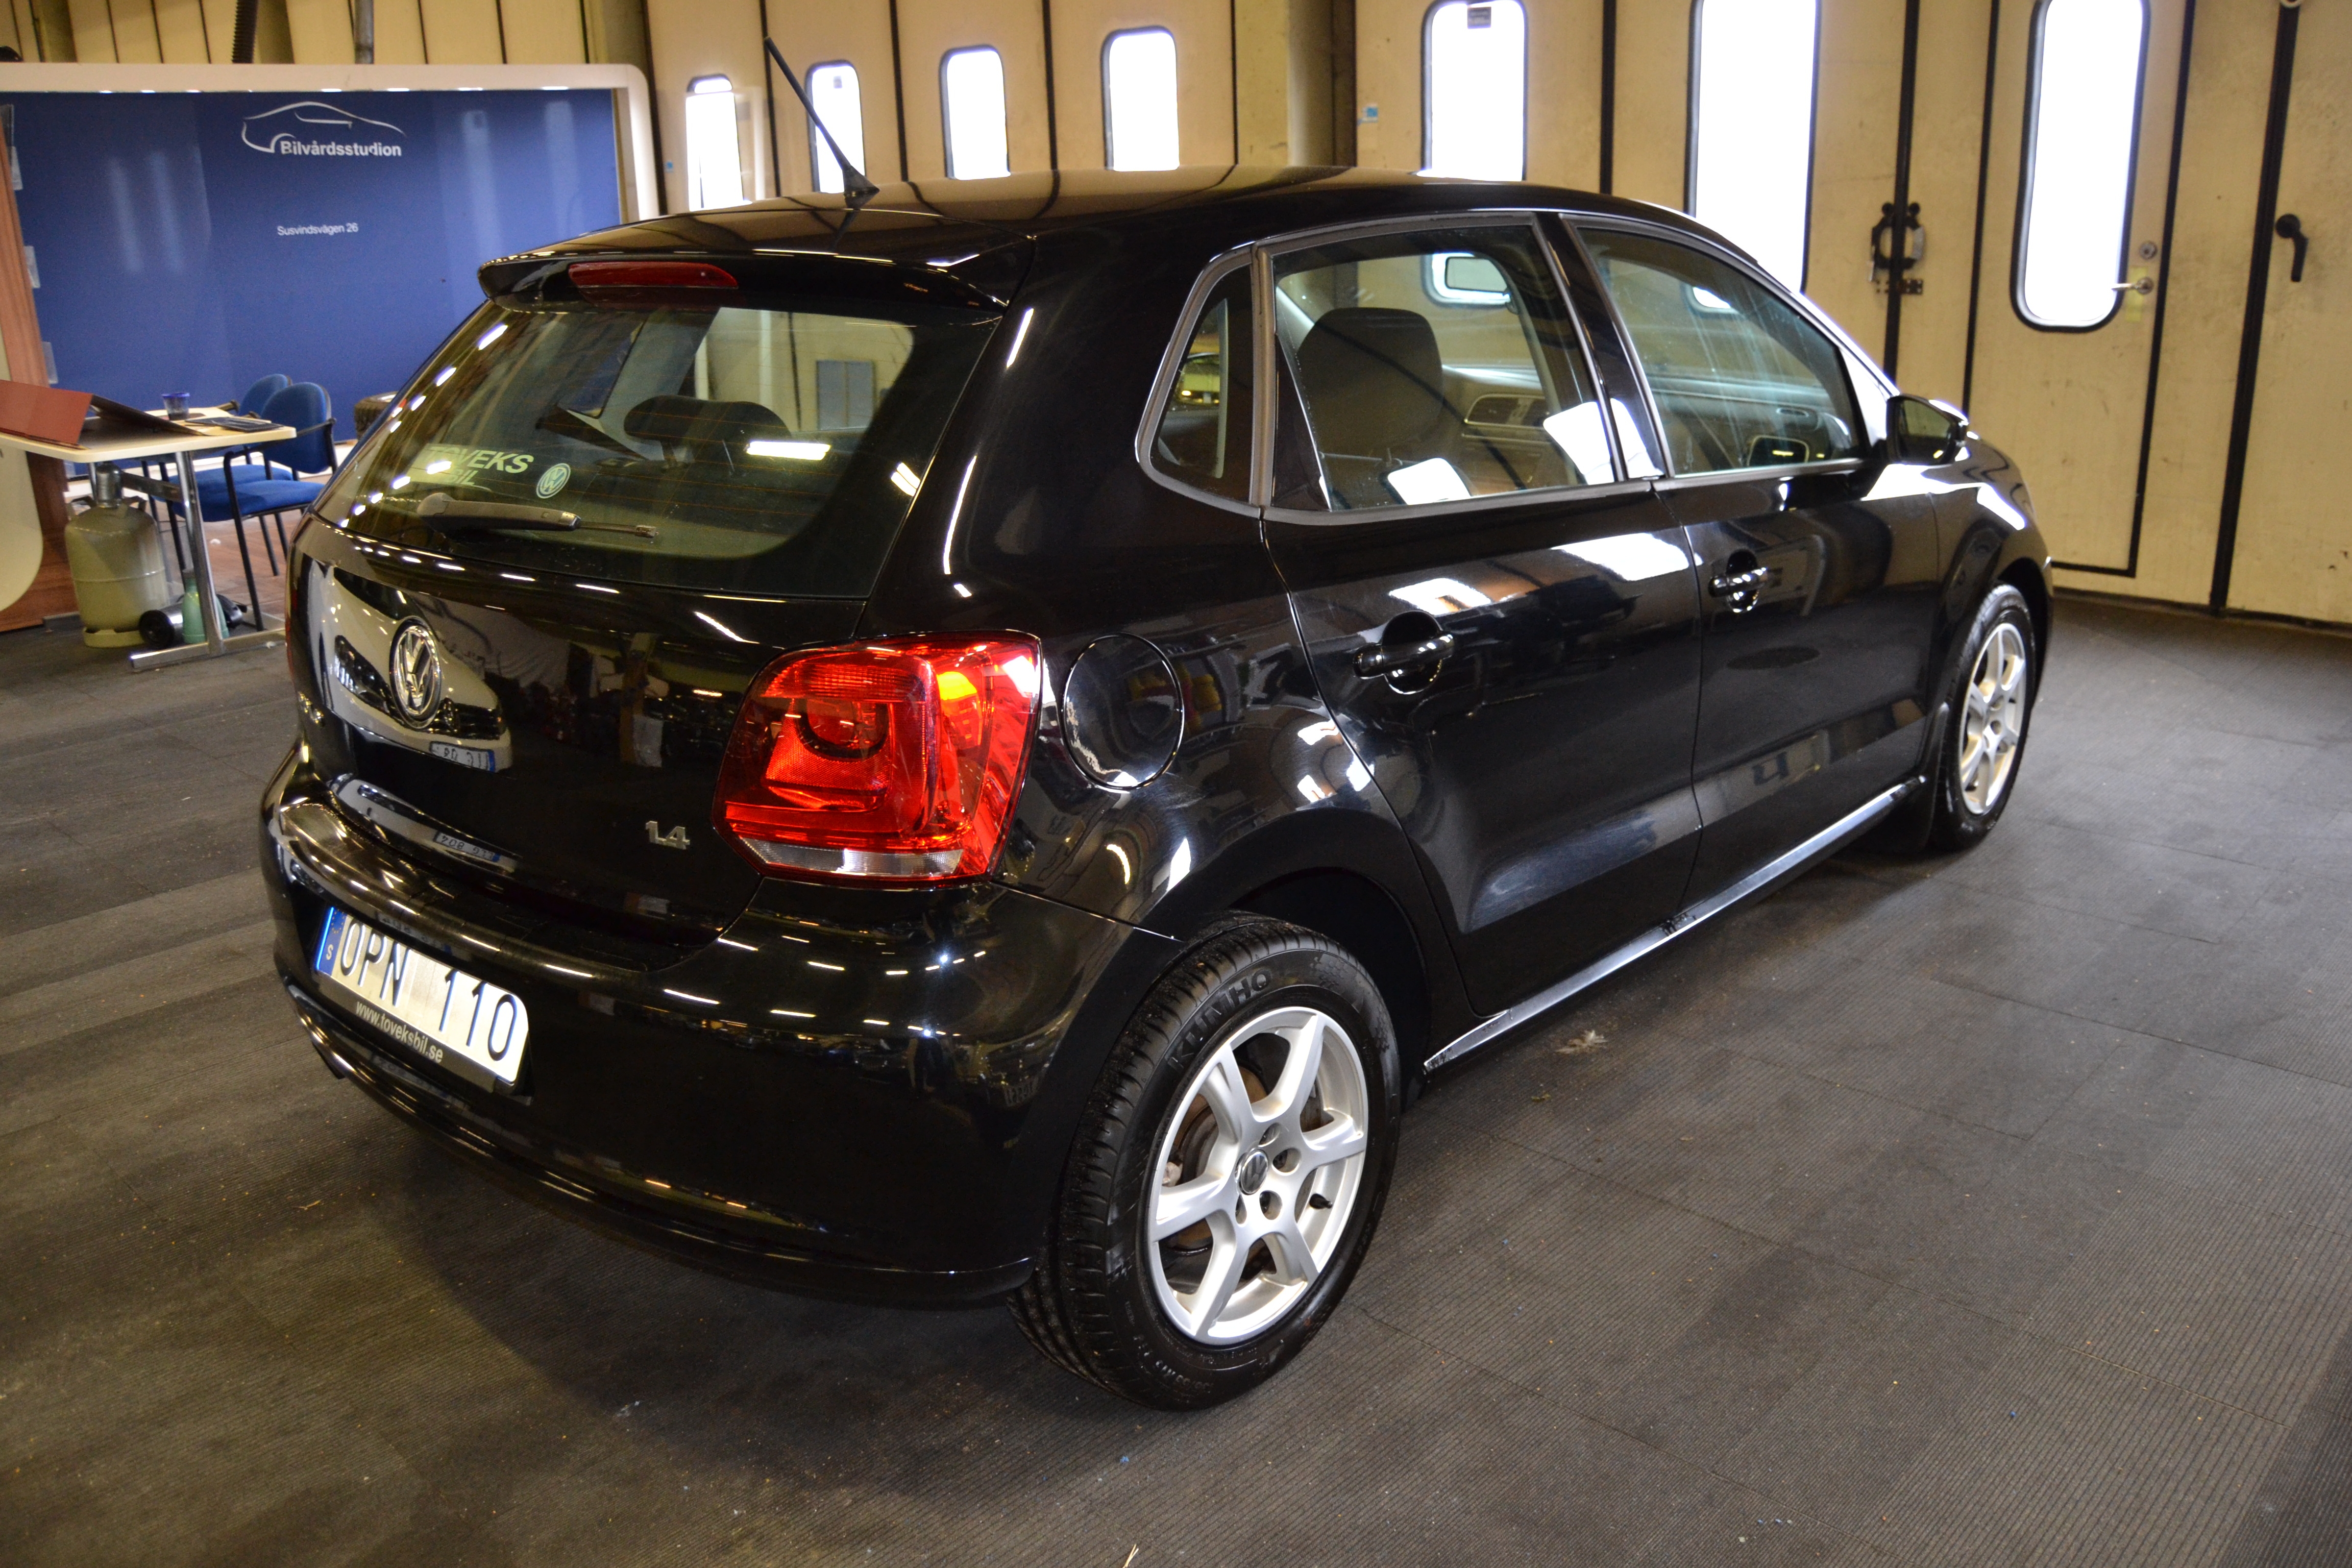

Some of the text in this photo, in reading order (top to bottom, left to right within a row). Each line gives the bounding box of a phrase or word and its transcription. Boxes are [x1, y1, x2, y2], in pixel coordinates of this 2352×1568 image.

[280, 140, 402, 156] Bilvårdsstudion
[346, 223, 358, 233] 26
[326, 944, 334, 960] S
[341, 920, 412, 1008] OPN
[439, 968, 518, 1062] 110
[357, 1001, 444, 1064] www.toveksbil.se
[1167, 969, 1272, 1071] KUMHO
